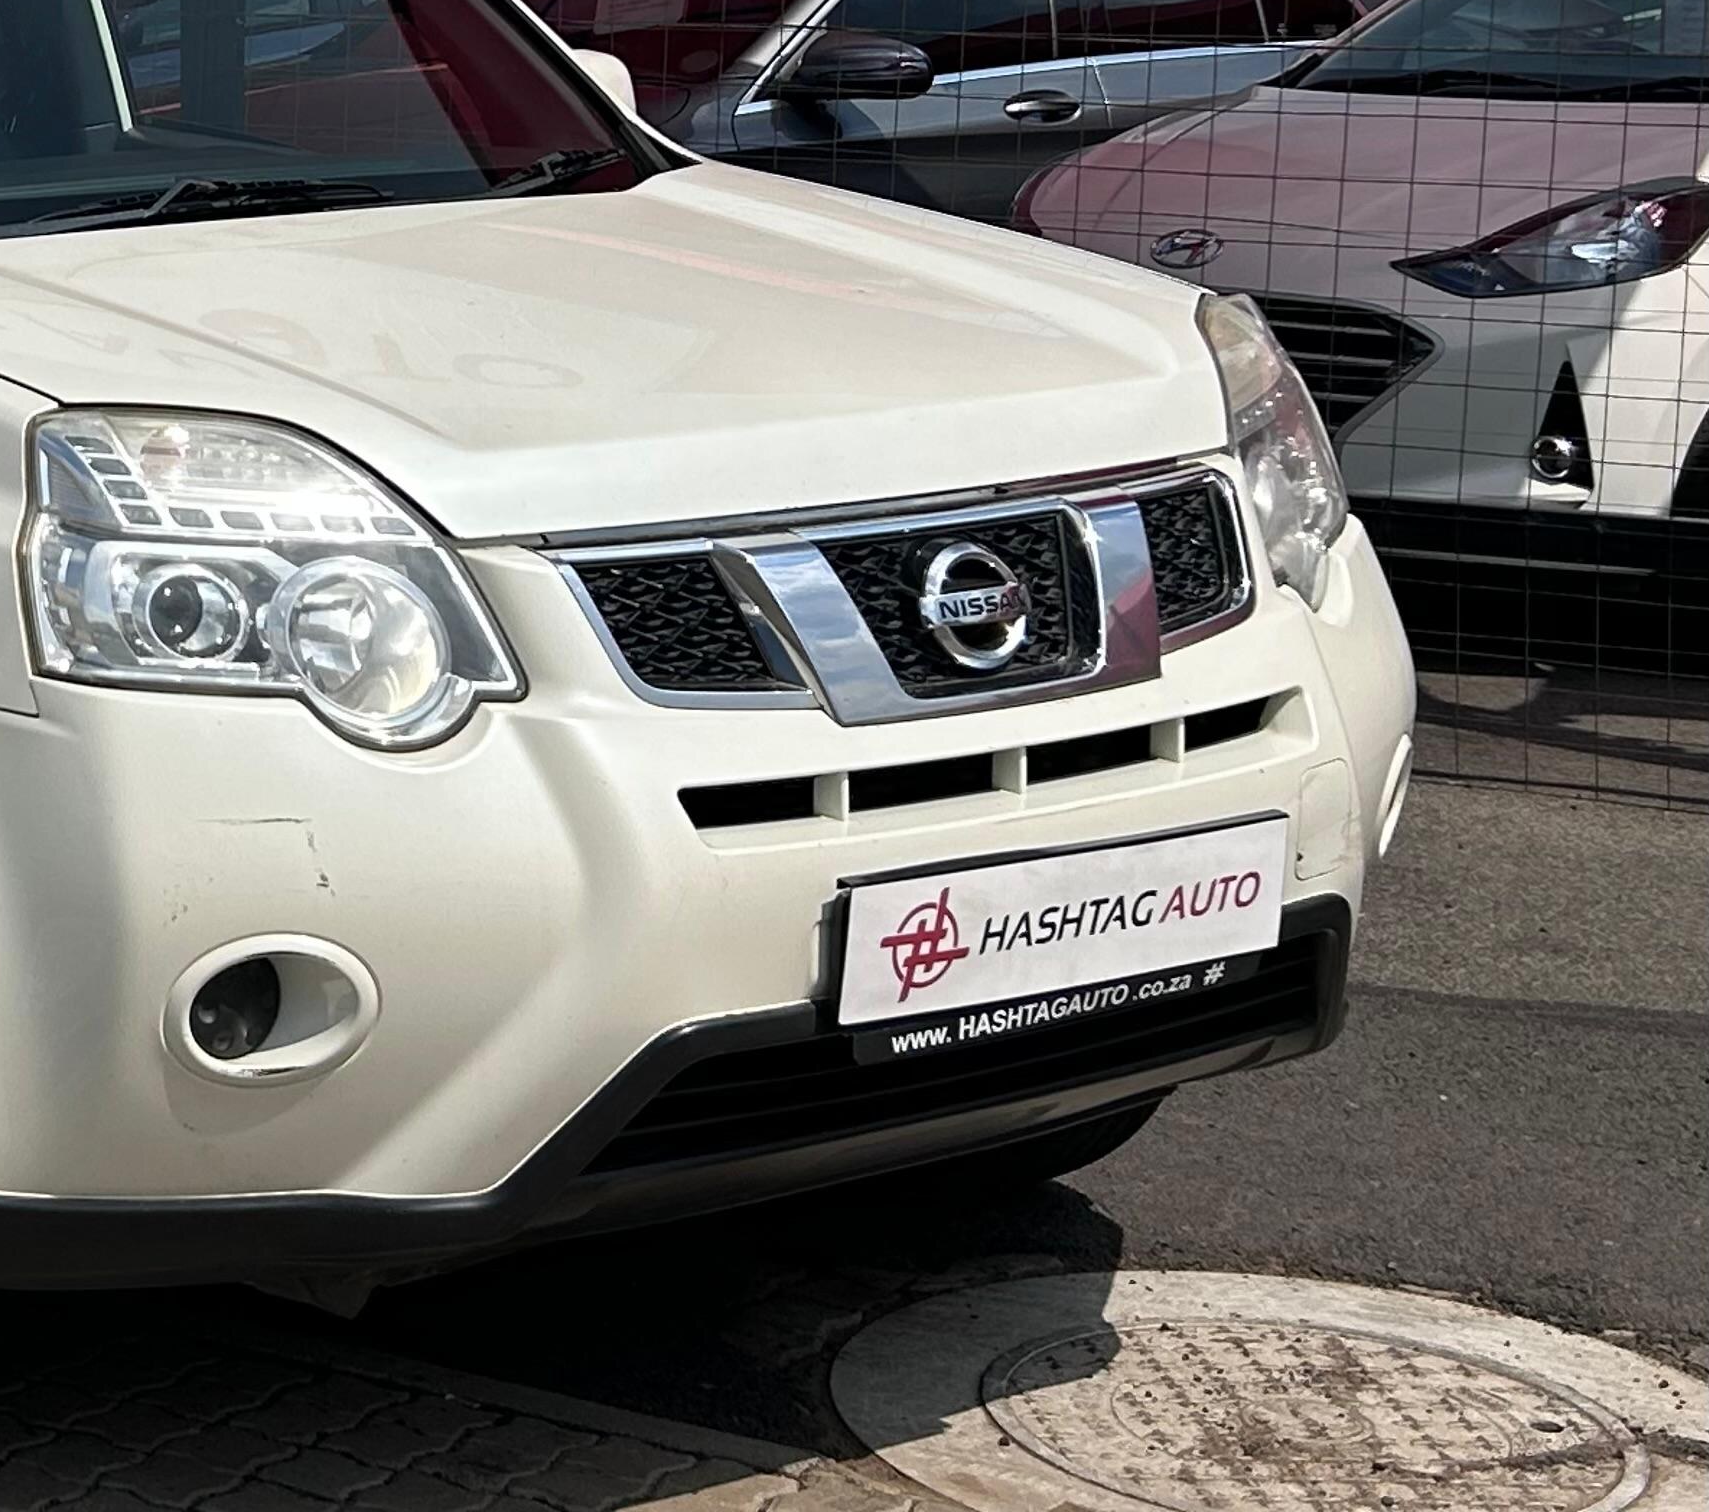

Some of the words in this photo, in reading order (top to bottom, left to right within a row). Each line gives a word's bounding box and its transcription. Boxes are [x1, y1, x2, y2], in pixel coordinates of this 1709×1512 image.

[938, 591, 1024, 620] NISSAN
[979, 890, 1158, 955] HASHTAG
[1158, 872, 1262, 923] AUTO
[959, 984, 1129, 1040] HASHTAGAUTO
